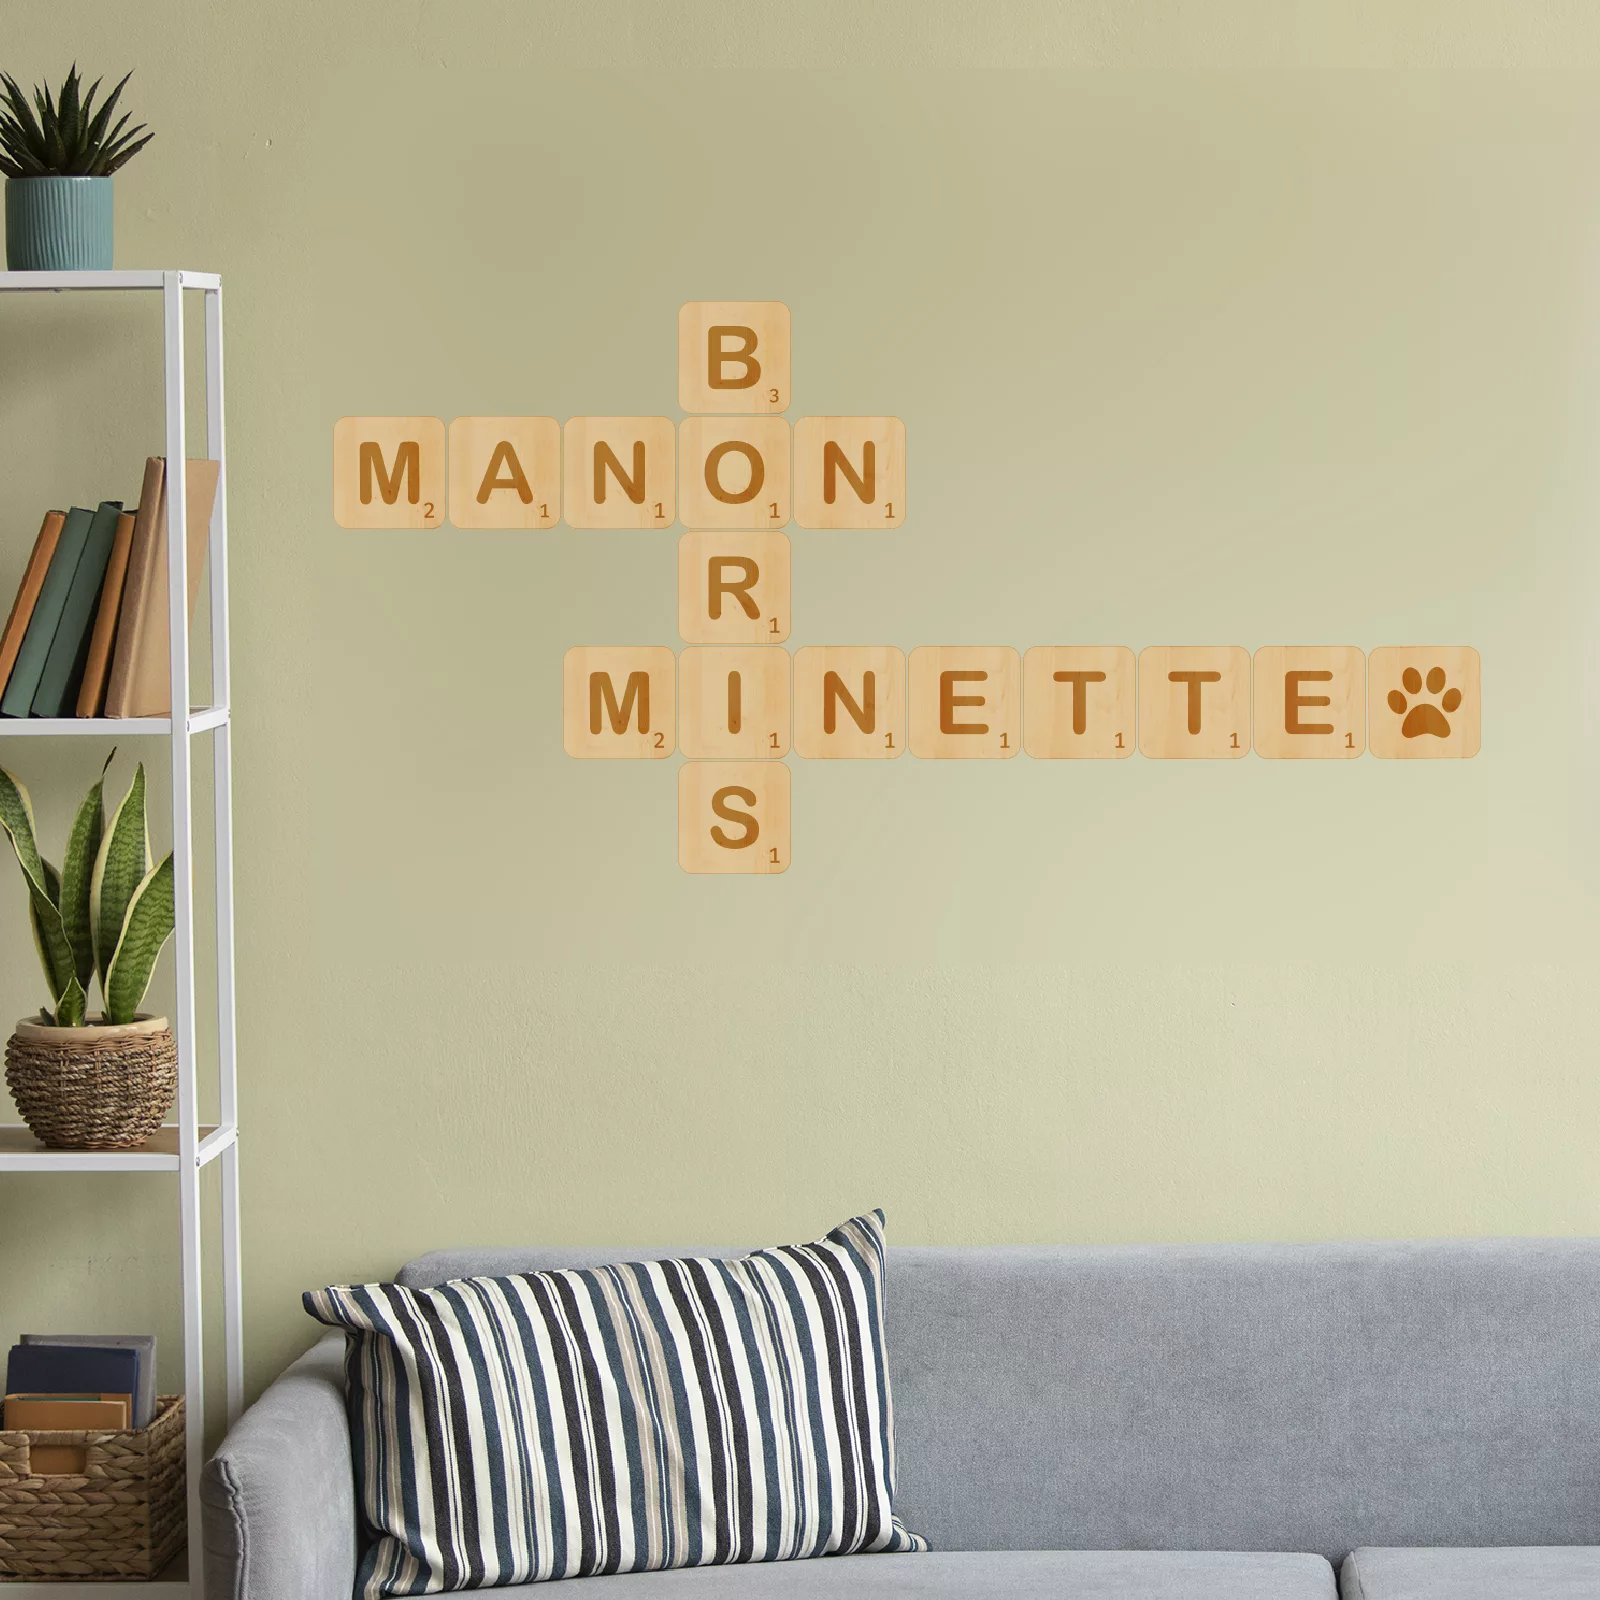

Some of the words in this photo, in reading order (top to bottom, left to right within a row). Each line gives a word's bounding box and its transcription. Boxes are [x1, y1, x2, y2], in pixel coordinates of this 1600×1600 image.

[769, 388, 779, 404] 3
[359, 440, 877, 505] MANON
[423, 502, 435, 519] 2
[540, 502, 550, 519] 1
[653, 502, 665, 519] 1
[769, 502, 781, 519] 1
[885, 502, 895, 519] 1
[704, 325, 765, 850] BORIS
[769, 617, 780, 634] 1
[589, 670, 1335, 736] MINETTE
[653, 732, 665, 749] 2
[769, 732, 780, 749] 1
[885, 732, 896, 749] 1
[1000, 732, 1011, 749] 1
[1115, 732, 1126, 749] 1
[1231, 732, 1242, 749] 1
[1345, 732, 1356, 749] 1
[769, 847, 780, 864] 1
